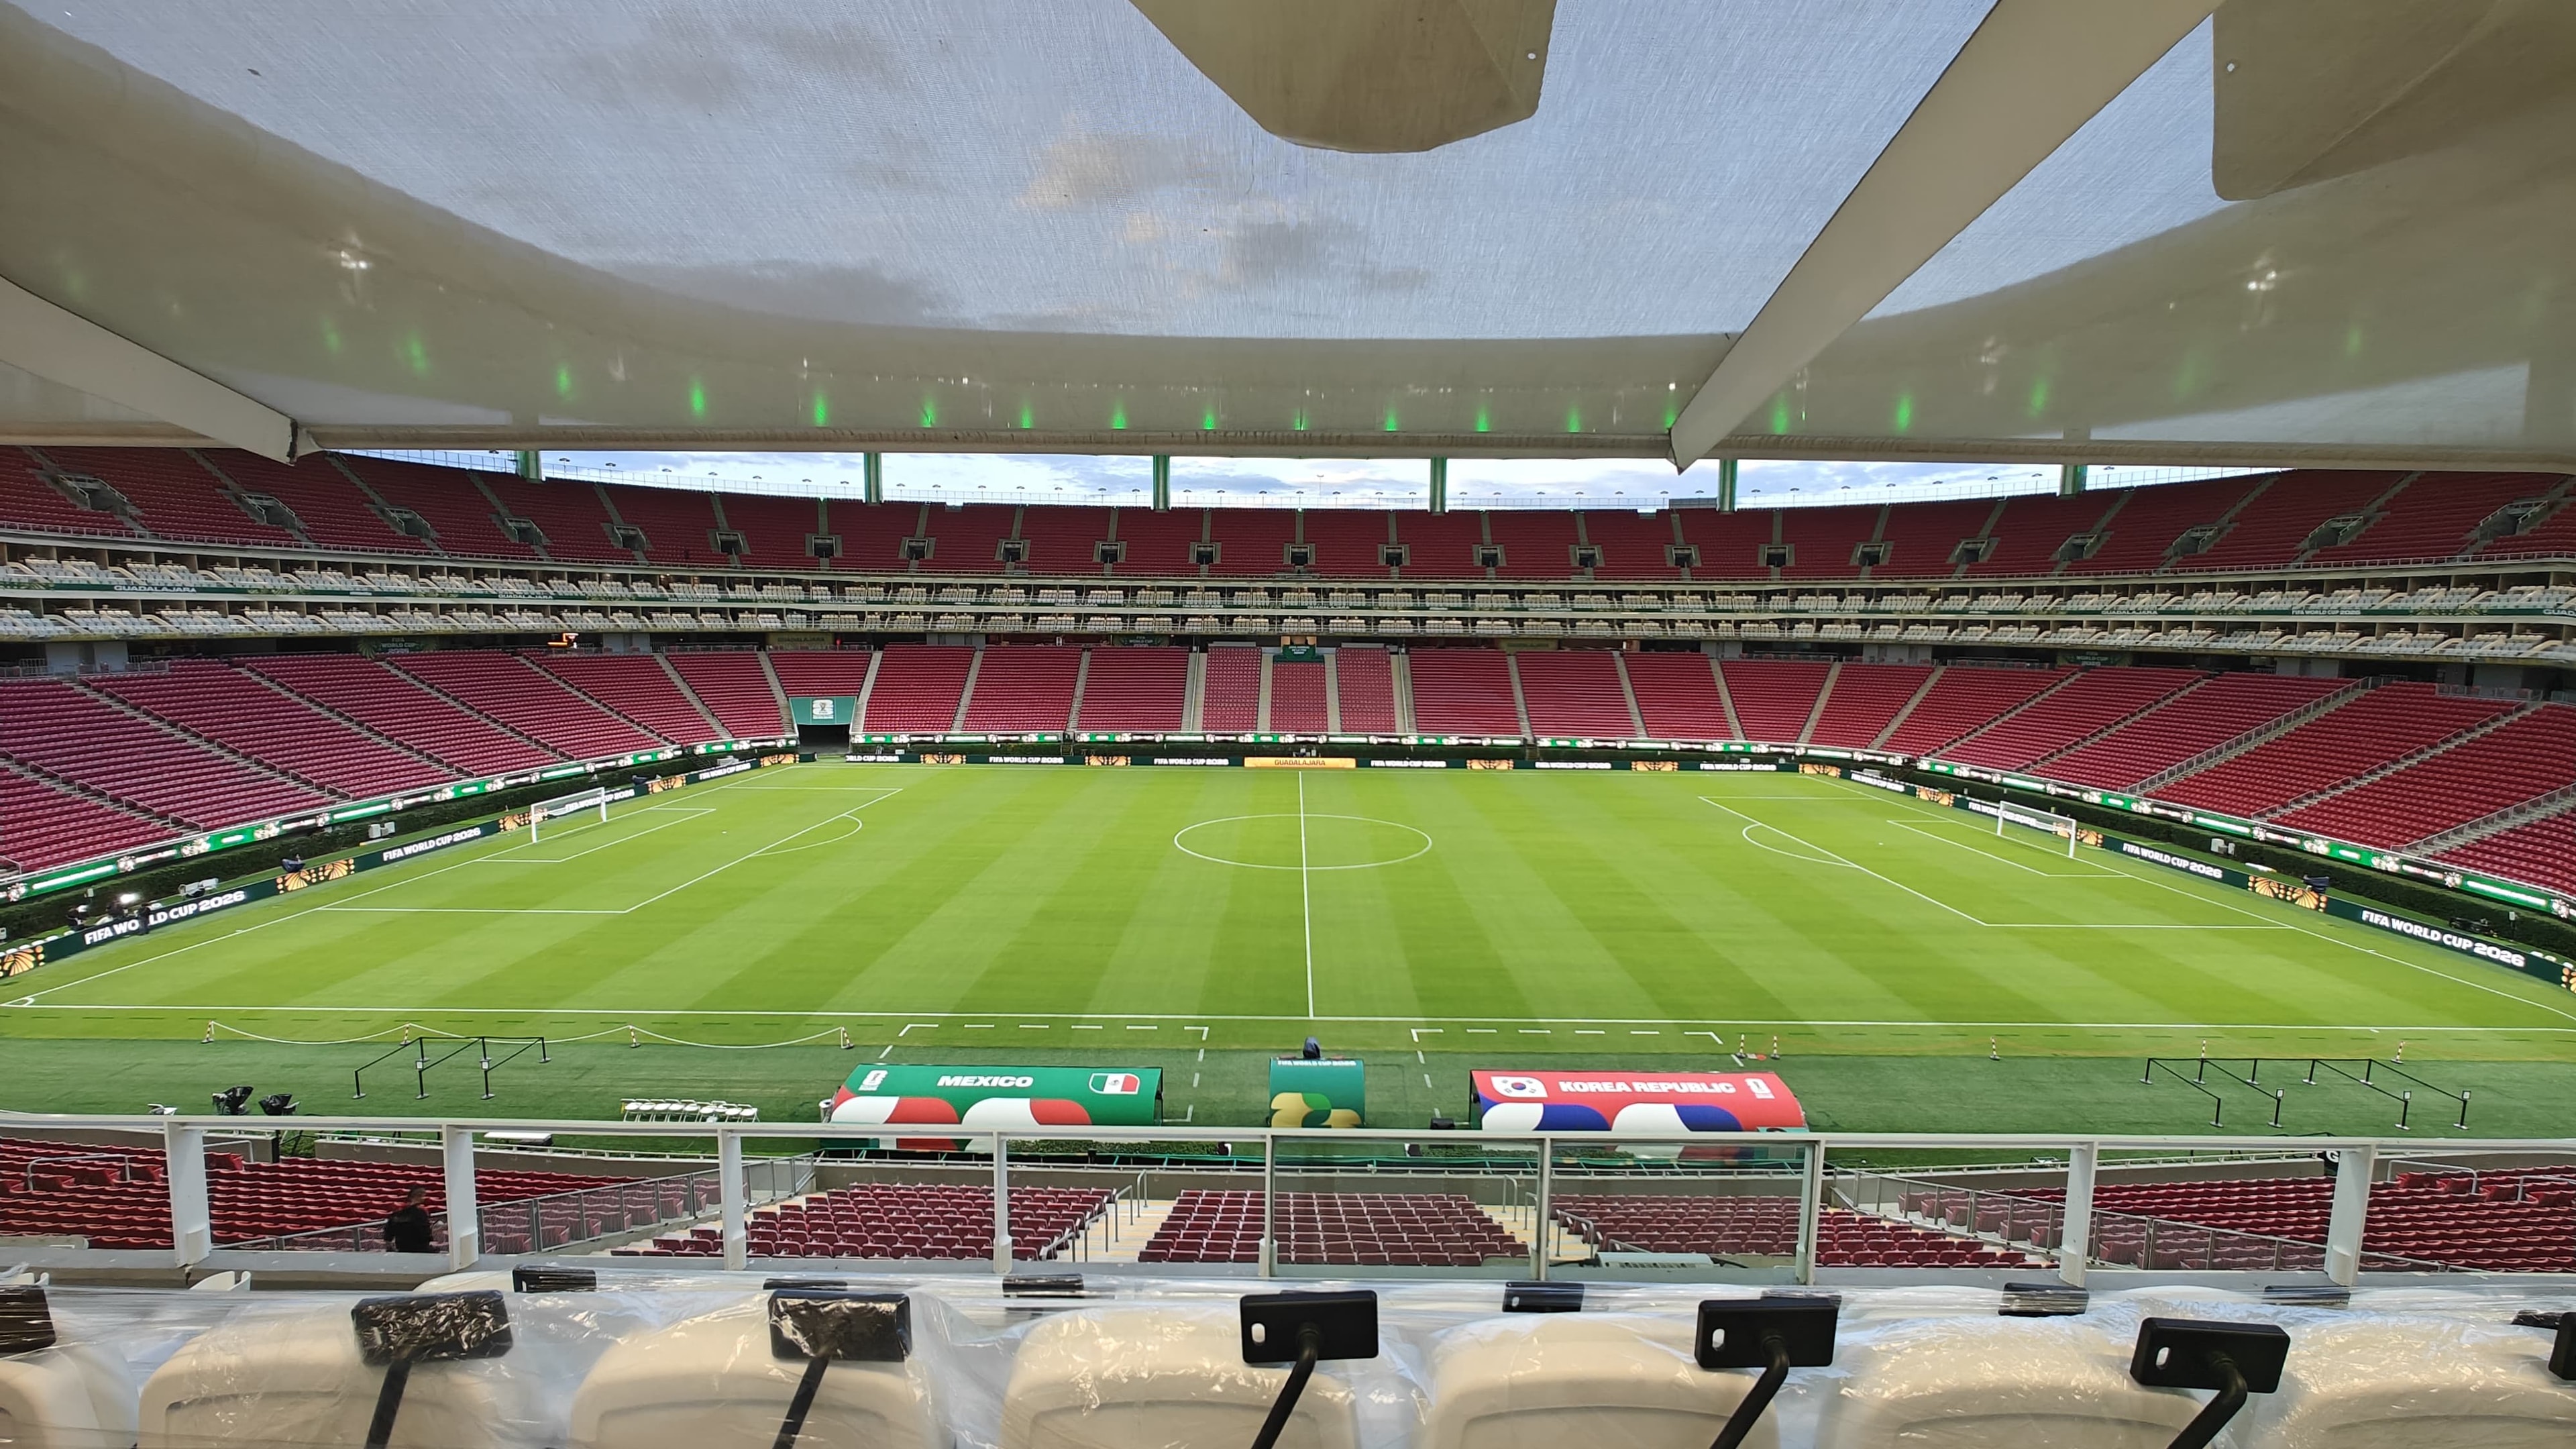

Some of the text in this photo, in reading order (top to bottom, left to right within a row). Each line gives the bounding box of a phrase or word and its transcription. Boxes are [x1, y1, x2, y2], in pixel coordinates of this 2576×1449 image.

[114, 585, 197, 593] GUADALAJARA
[382, 827, 482, 861] FIFA WORLD CUP 2026
[2123, 843, 2223, 879] FIFA WORLD CUP 2026
[85, 890, 246, 945] FIFA WOLD CUP 2026
[2361, 910, 2526, 967] FIFA WORLD CUP 2026
[936, 1075, 1034, 1088] MEXICO
[1558, 1081, 1737, 1094] KOREA REPUBLIC
